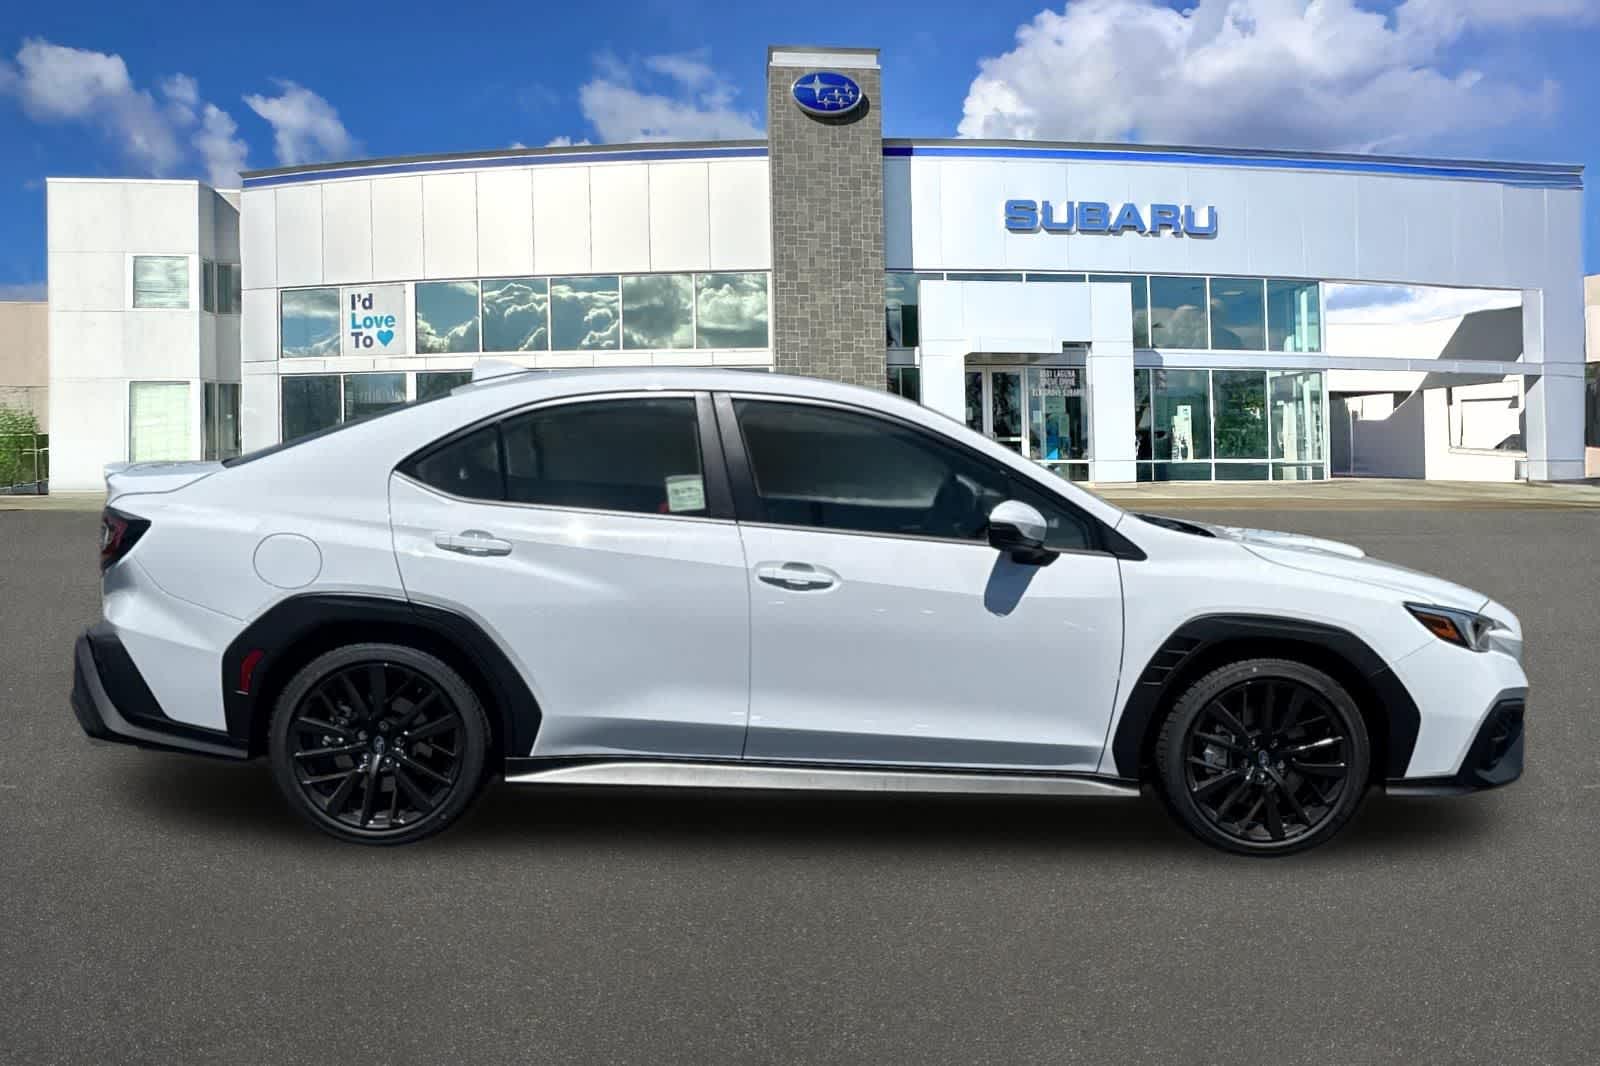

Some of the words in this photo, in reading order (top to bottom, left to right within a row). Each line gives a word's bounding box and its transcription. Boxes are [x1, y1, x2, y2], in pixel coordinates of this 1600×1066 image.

[1005, 200, 1218, 239] SUBARU
[351, 293, 373, 310] I'd
[351, 312, 396, 329] Love
[351, 331, 374, 348] To
